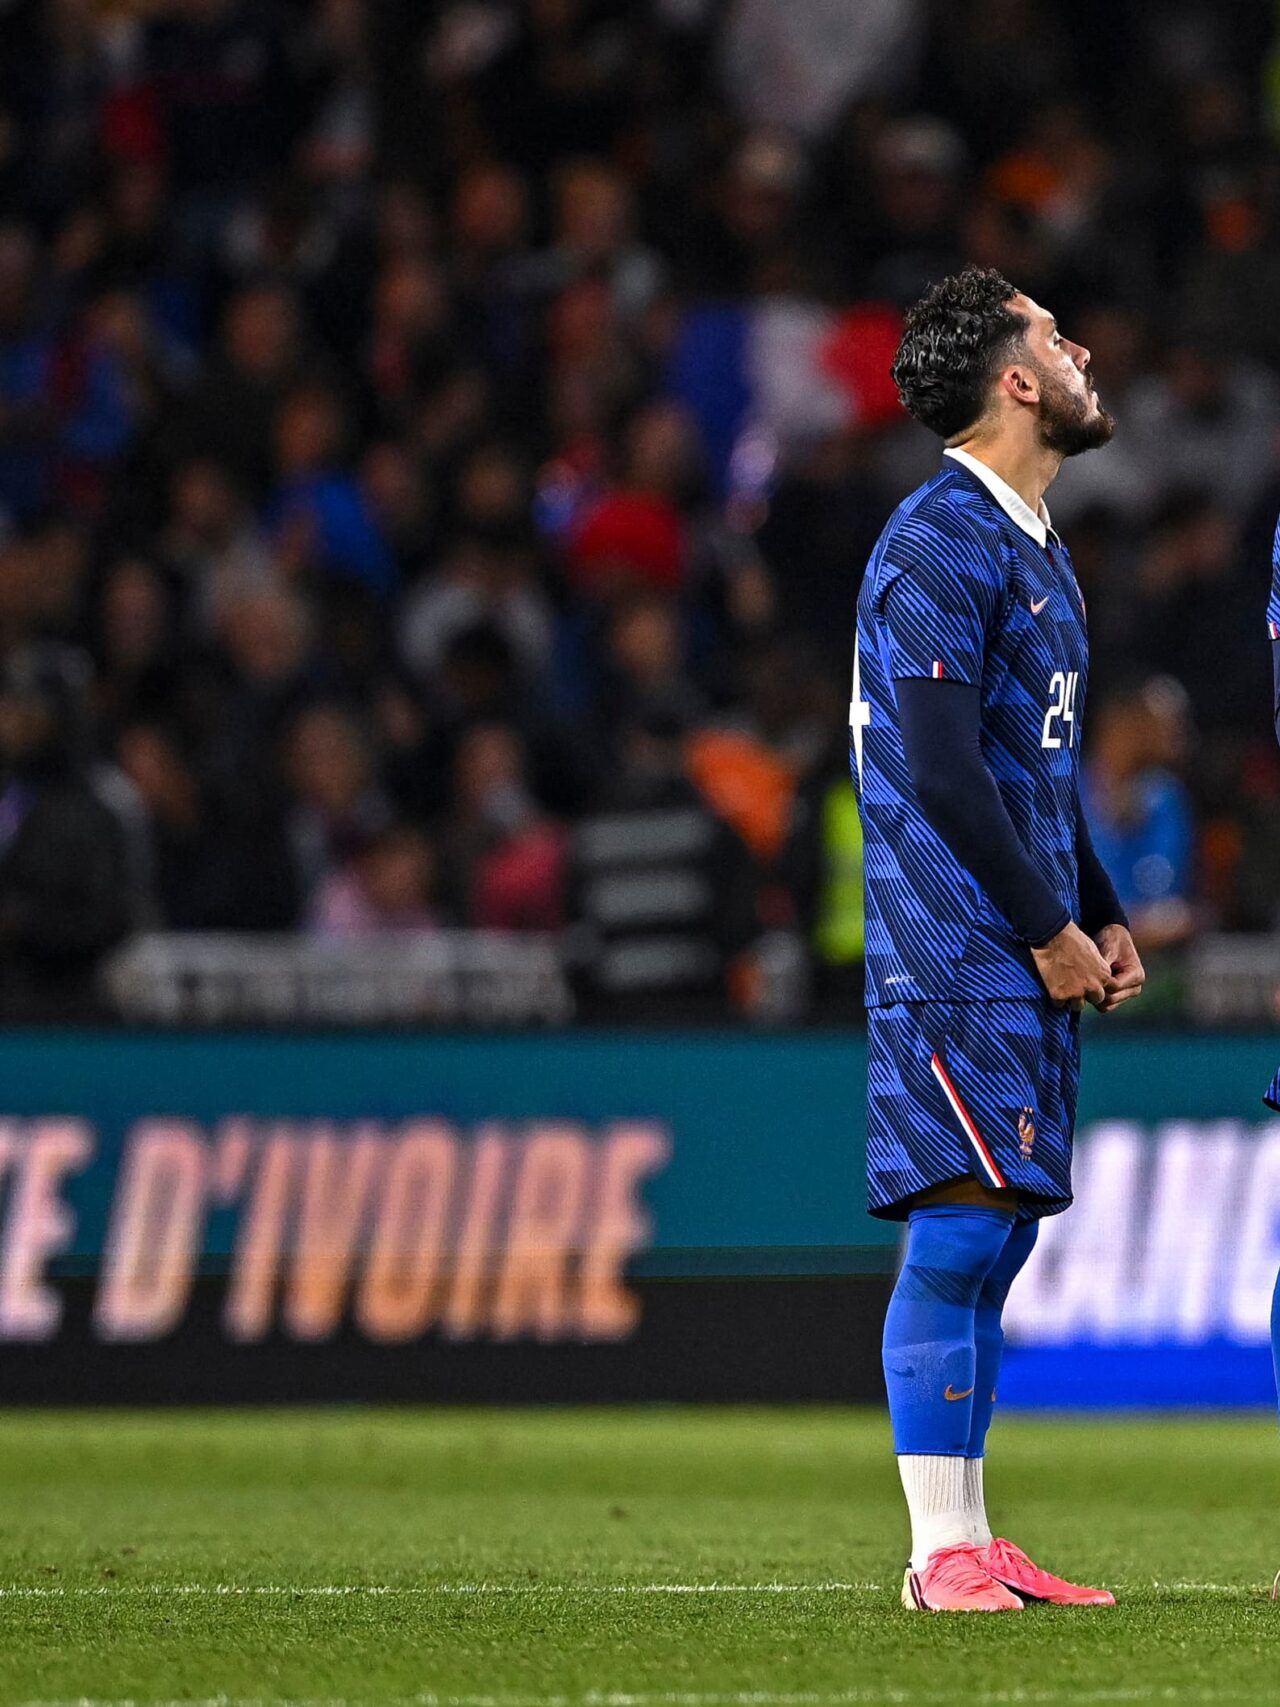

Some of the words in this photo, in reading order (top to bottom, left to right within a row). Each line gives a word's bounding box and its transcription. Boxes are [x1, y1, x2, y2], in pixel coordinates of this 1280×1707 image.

[1041, 671, 1078, 748] 24
[0, 1118, 94, 1338] E
[96, 1117, 670, 1340] D'IVOIRE
